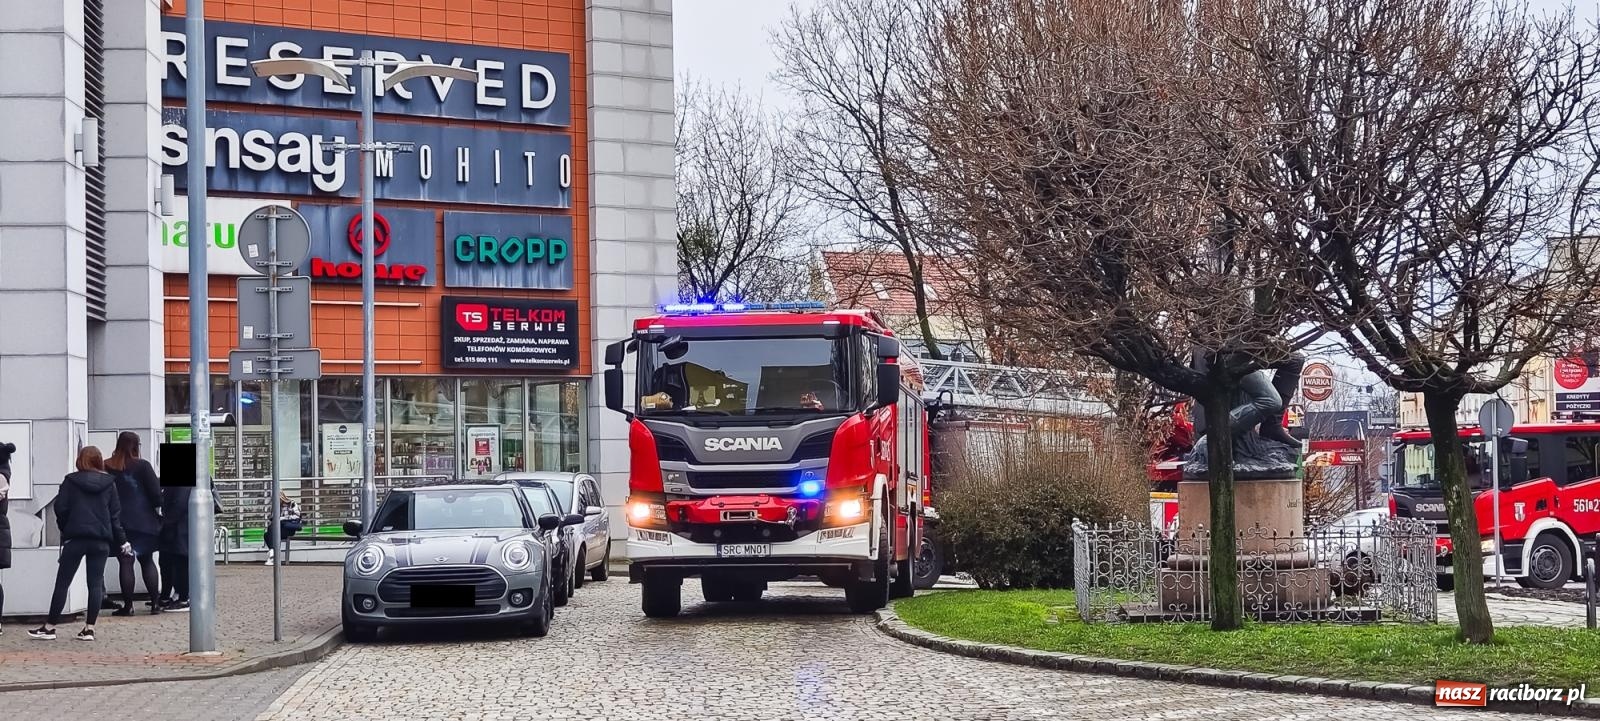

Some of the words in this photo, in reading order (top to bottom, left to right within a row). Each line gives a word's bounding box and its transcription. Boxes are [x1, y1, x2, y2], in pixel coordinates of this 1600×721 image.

[161, 31, 557, 110] RESERVED
[161, 123, 346, 192] snsay
[374, 141, 571, 188] MOHITO
[455, 234, 568, 265] CROPP
[462, 312, 482, 322] TS
[490, 308, 565, 322] TELKOM
[493, 322, 565, 331] SERWIS
[472, 336, 505, 344] SPRZEDAŻ,
[704, 437, 782, 451] SCANIA
[724, 545, 741, 554] SRC
[745, 545, 767, 555] MN01
